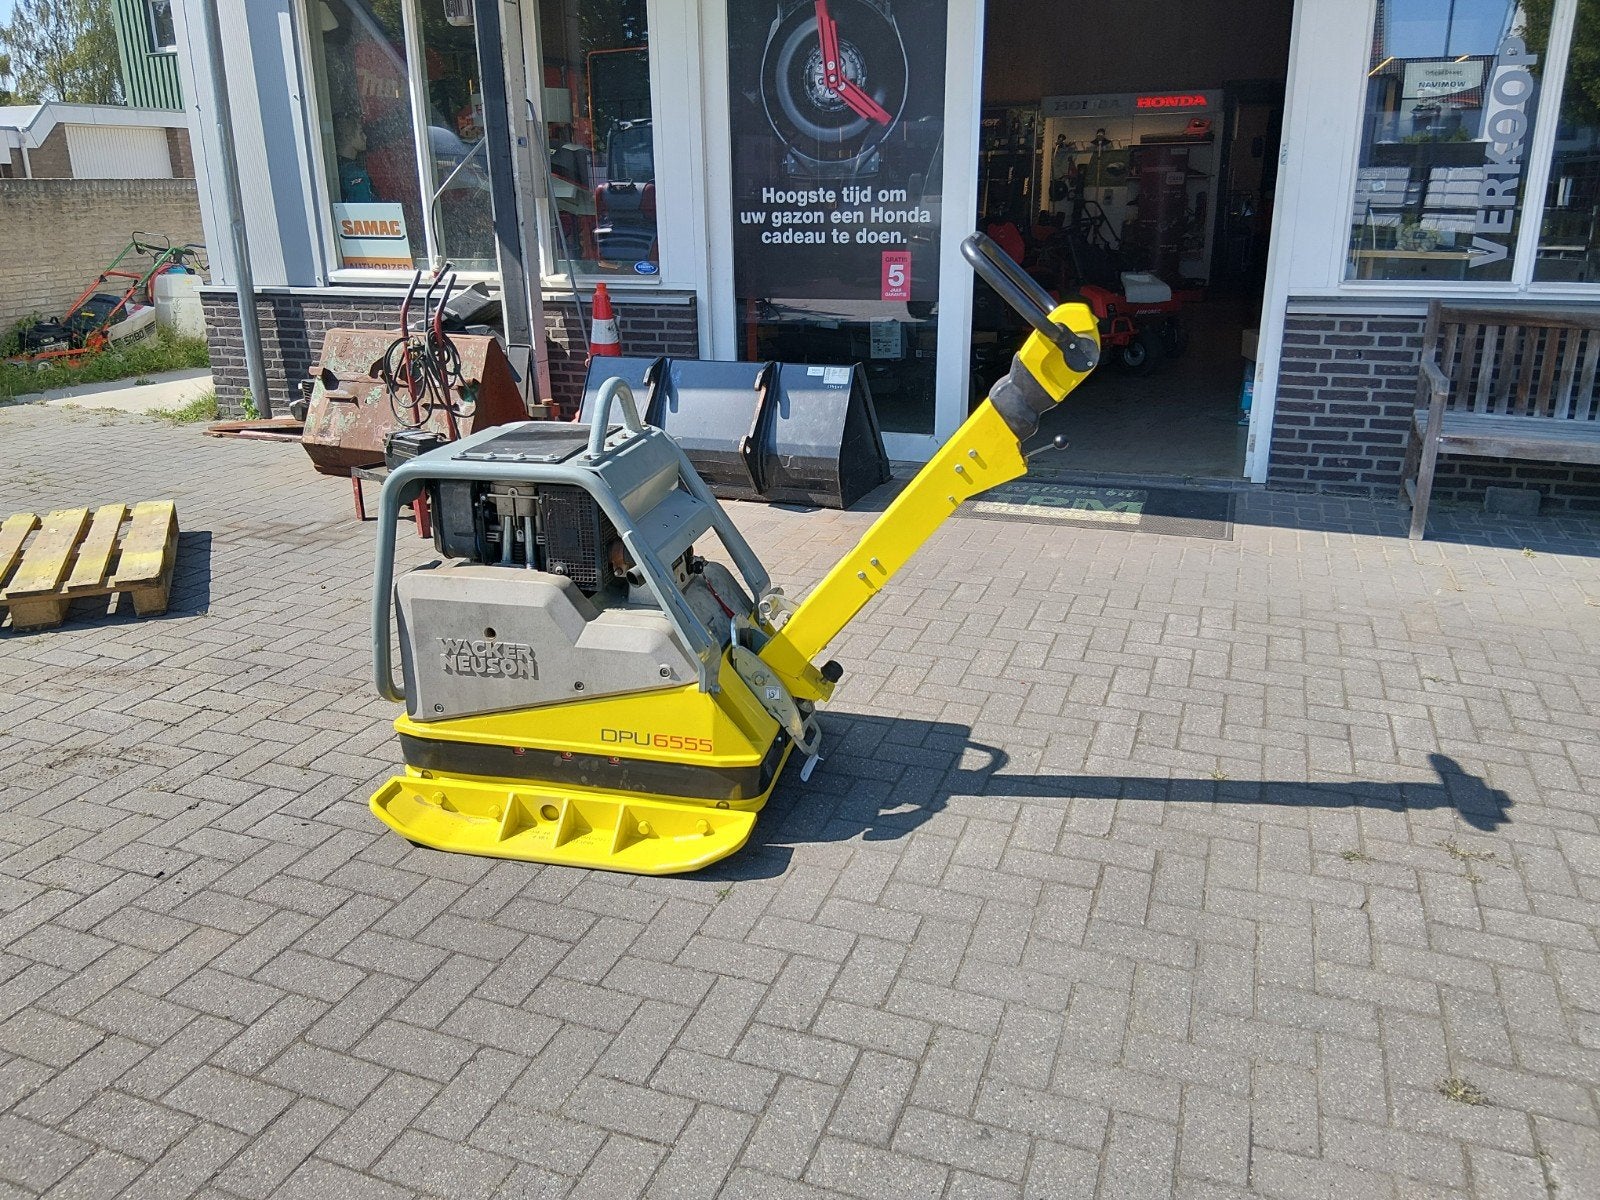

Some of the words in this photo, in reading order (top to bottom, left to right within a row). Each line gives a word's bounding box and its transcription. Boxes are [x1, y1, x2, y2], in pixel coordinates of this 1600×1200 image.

[1136, 95, 1207, 108] HONDA
[1468, 37, 1538, 268] VERKOOP
[762, 187, 836, 206] Hoogste
[842, 186, 871, 206] tijd
[878, 190, 907, 203] om
[341, 219, 401, 236] SAMAC
[740, 211, 766, 224] uw
[771, 211, 825, 228] gazon
[830, 211, 864, 224] een
[870, 207, 931, 224] Honda
[761, 229, 826, 245] cadeau
[831, 229, 850, 244] te
[856, 228, 907, 244] doen.
[888, 264, 905, 287] 5
[436, 638, 536, 661] WACKER
[439, 653, 538, 678] NEUSON
